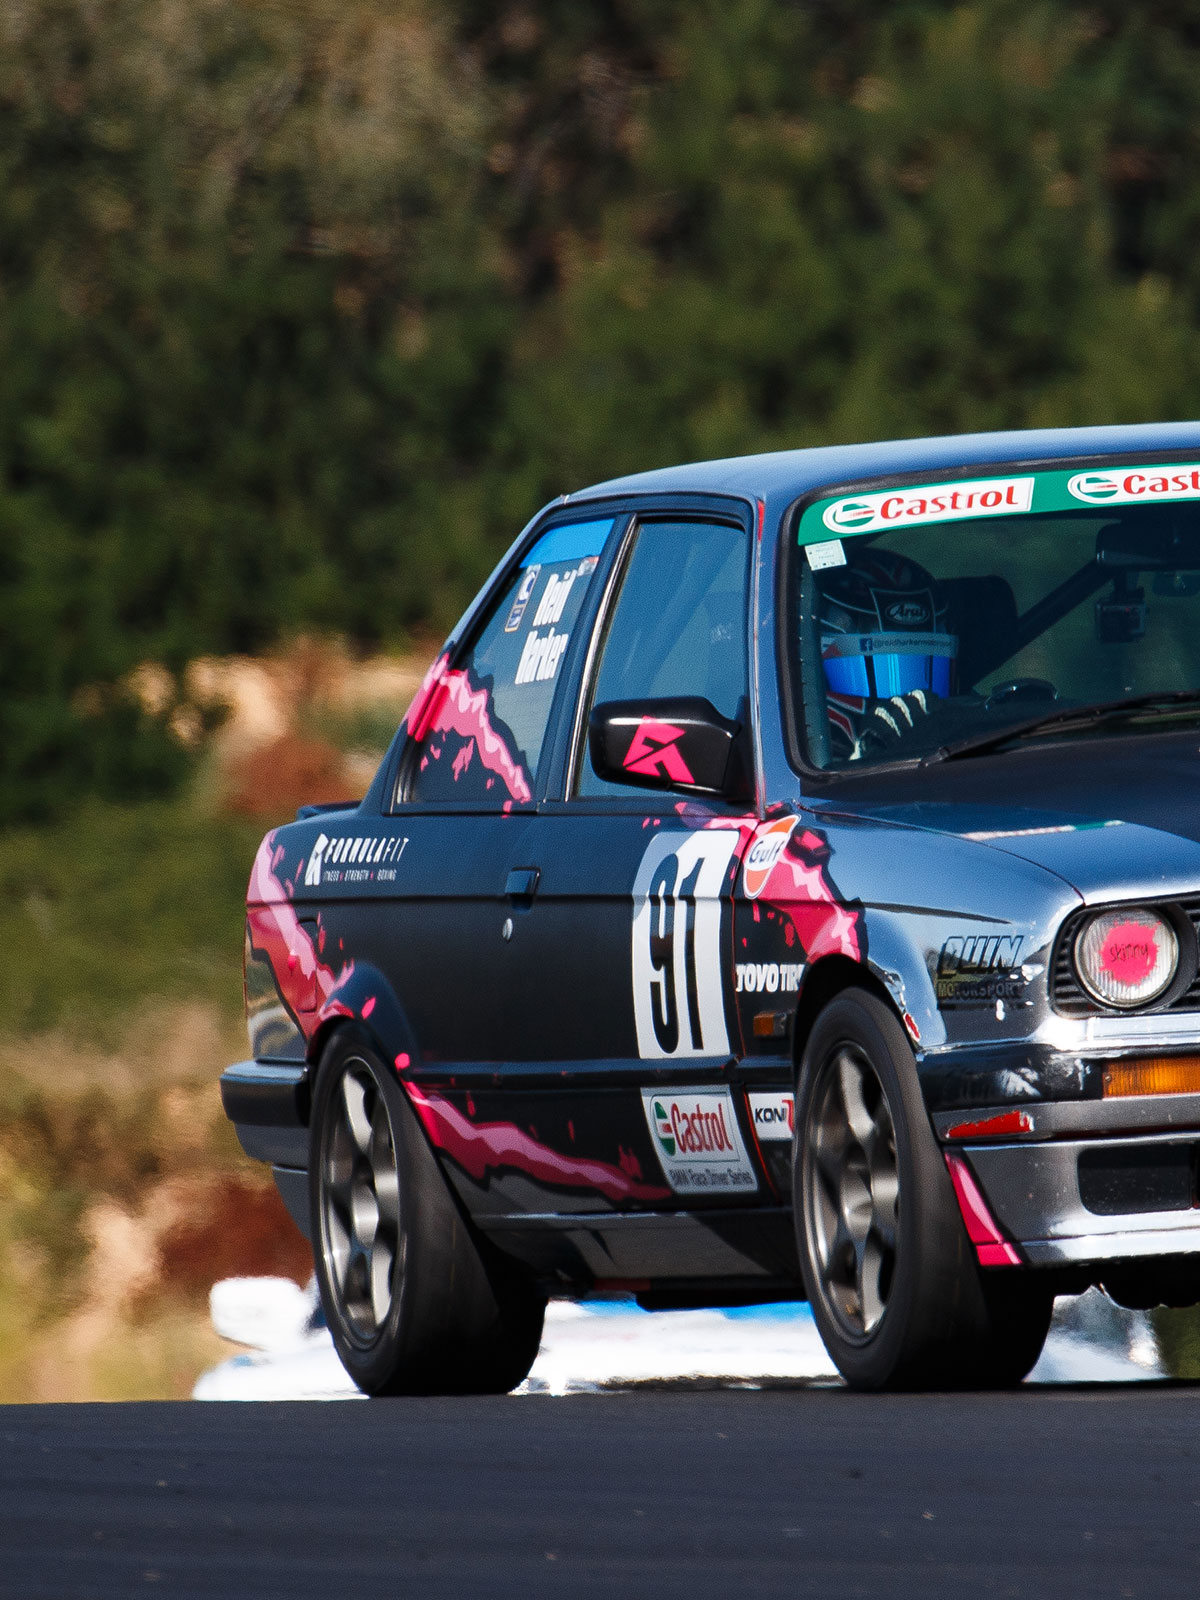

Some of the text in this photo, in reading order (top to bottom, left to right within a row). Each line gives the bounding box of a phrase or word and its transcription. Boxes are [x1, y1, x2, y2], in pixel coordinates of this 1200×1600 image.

[880, 485, 1018, 521] Castrol
[748, 840, 785, 864] Gulf
[649, 853, 706, 1054] 91
[937, 935, 1025, 979] QUIN
[735, 963, 779, 993] TOYO
[937, 981, 1023, 1000] MOTORSPORT
[671, 1102, 733, 1154] Castrol
